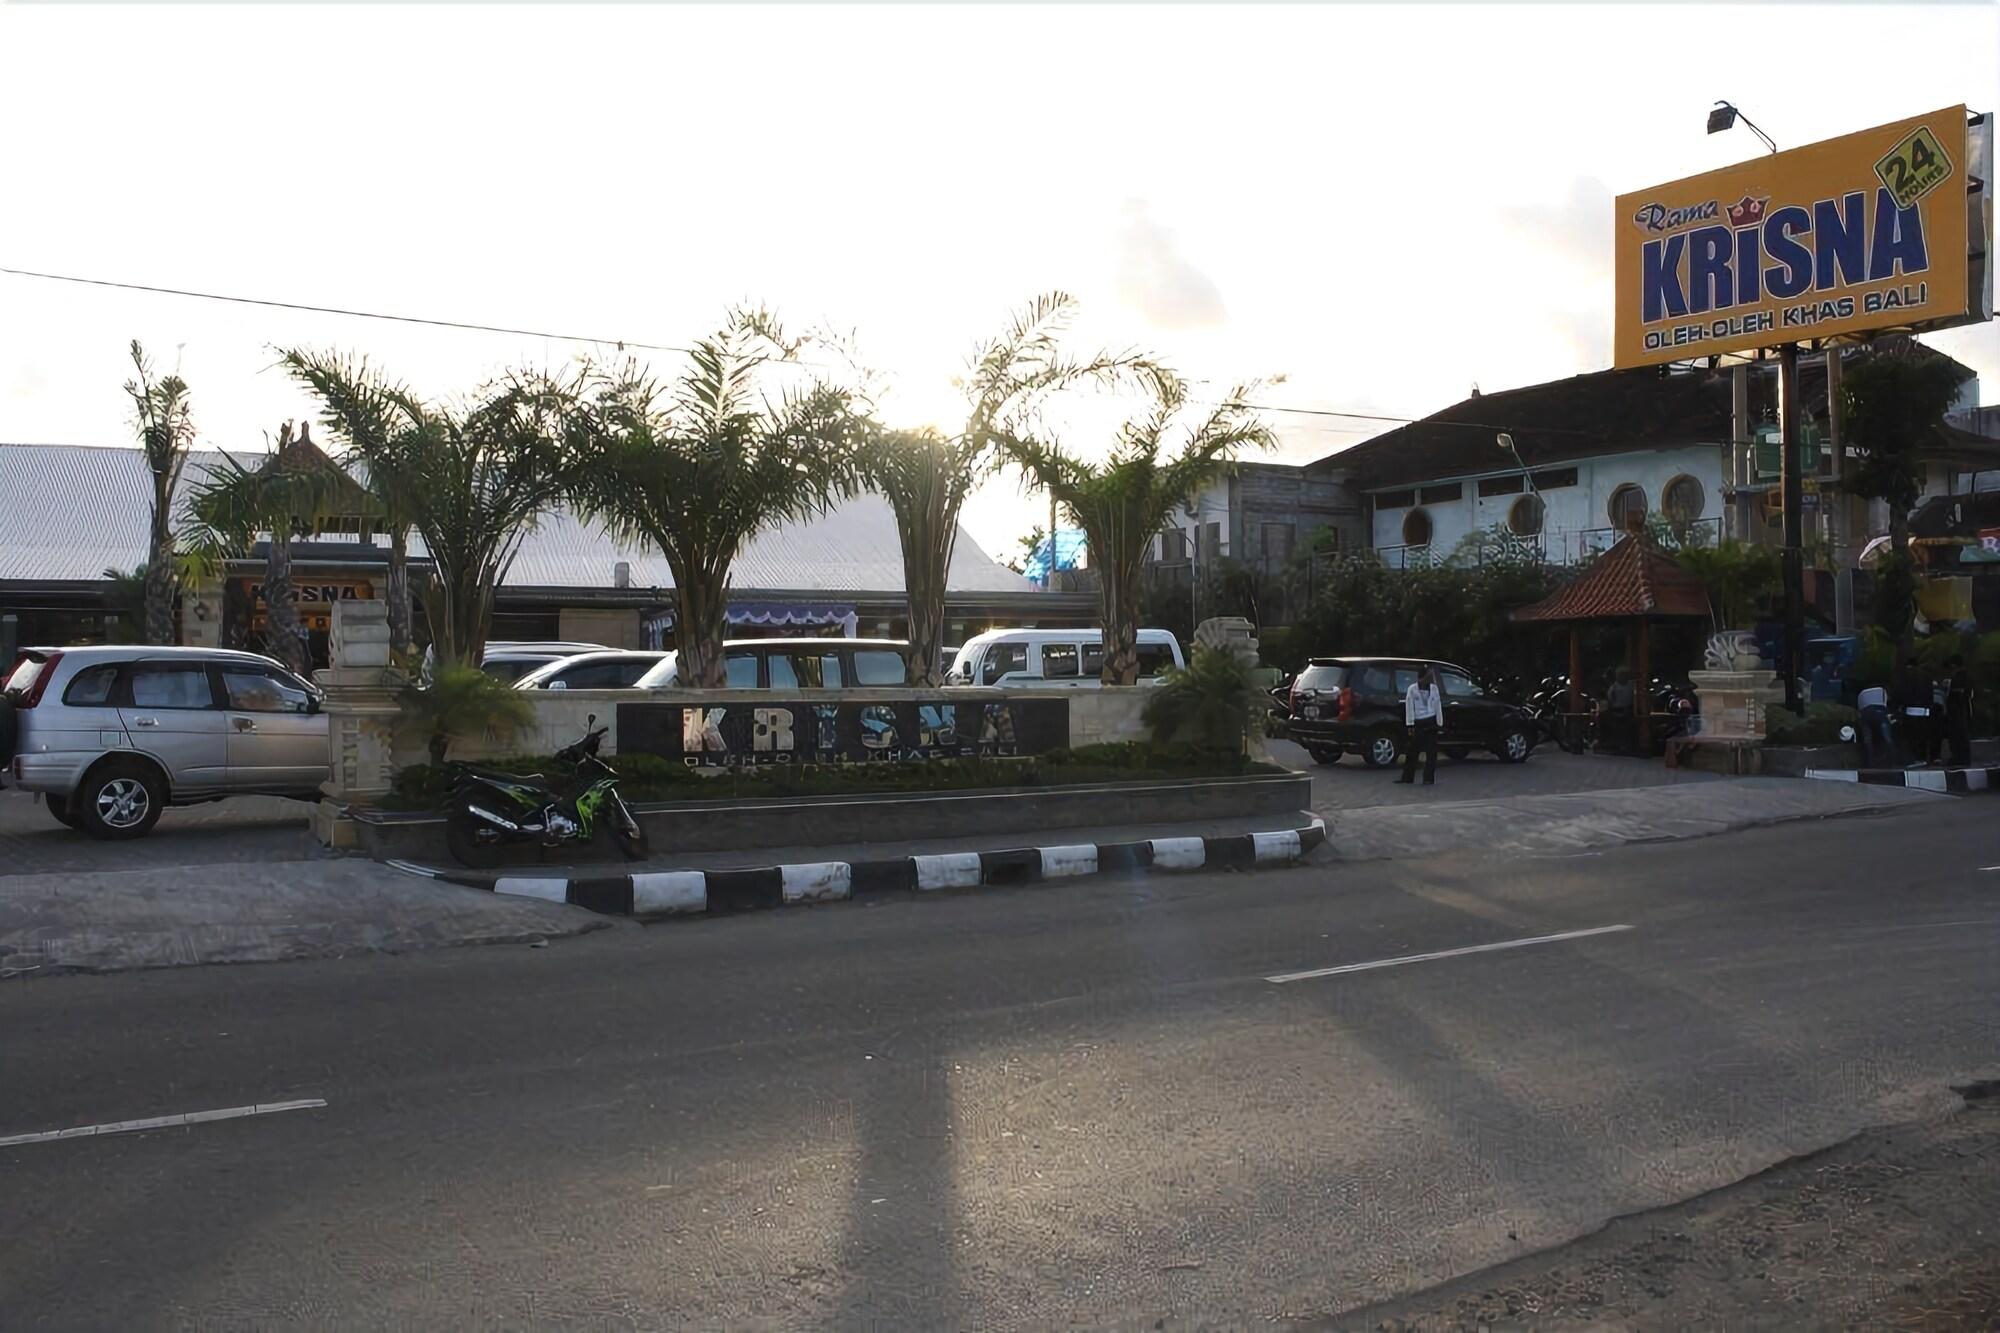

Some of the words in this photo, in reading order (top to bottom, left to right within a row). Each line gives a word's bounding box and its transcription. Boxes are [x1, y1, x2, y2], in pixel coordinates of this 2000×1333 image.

[1885, 138, 1936, 194] 24
[1633, 199, 1719, 232] Rama
[1643, 310, 1774, 349] OLEH-OLEH
[1781, 296, 1855, 328] KHAS
[1863, 281, 1928, 314] BALI
[683, 704, 1017, 752] KRISNA
